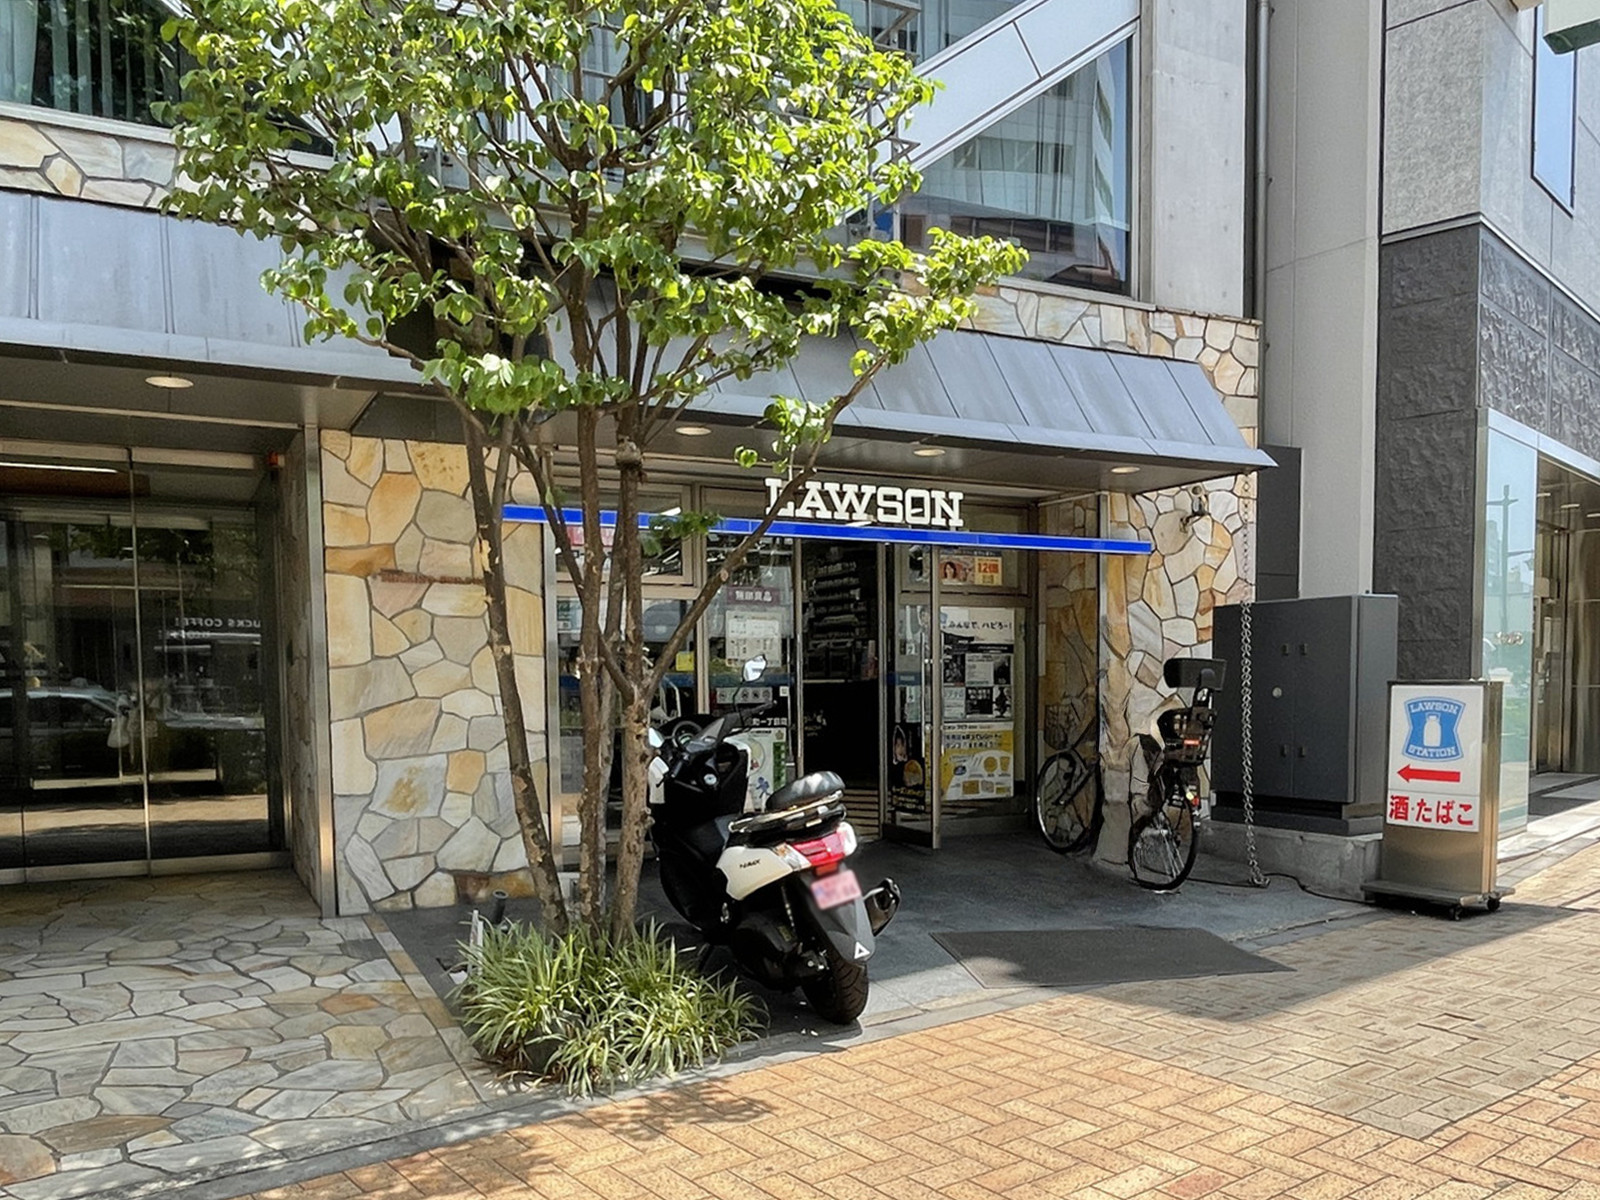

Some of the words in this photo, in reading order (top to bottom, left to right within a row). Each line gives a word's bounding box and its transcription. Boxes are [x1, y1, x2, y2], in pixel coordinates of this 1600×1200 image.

[765, 477, 964, 527] LAWSON
[1409, 701, 1459, 715] LAWSON
[1407, 744, 1456, 758] STATION
